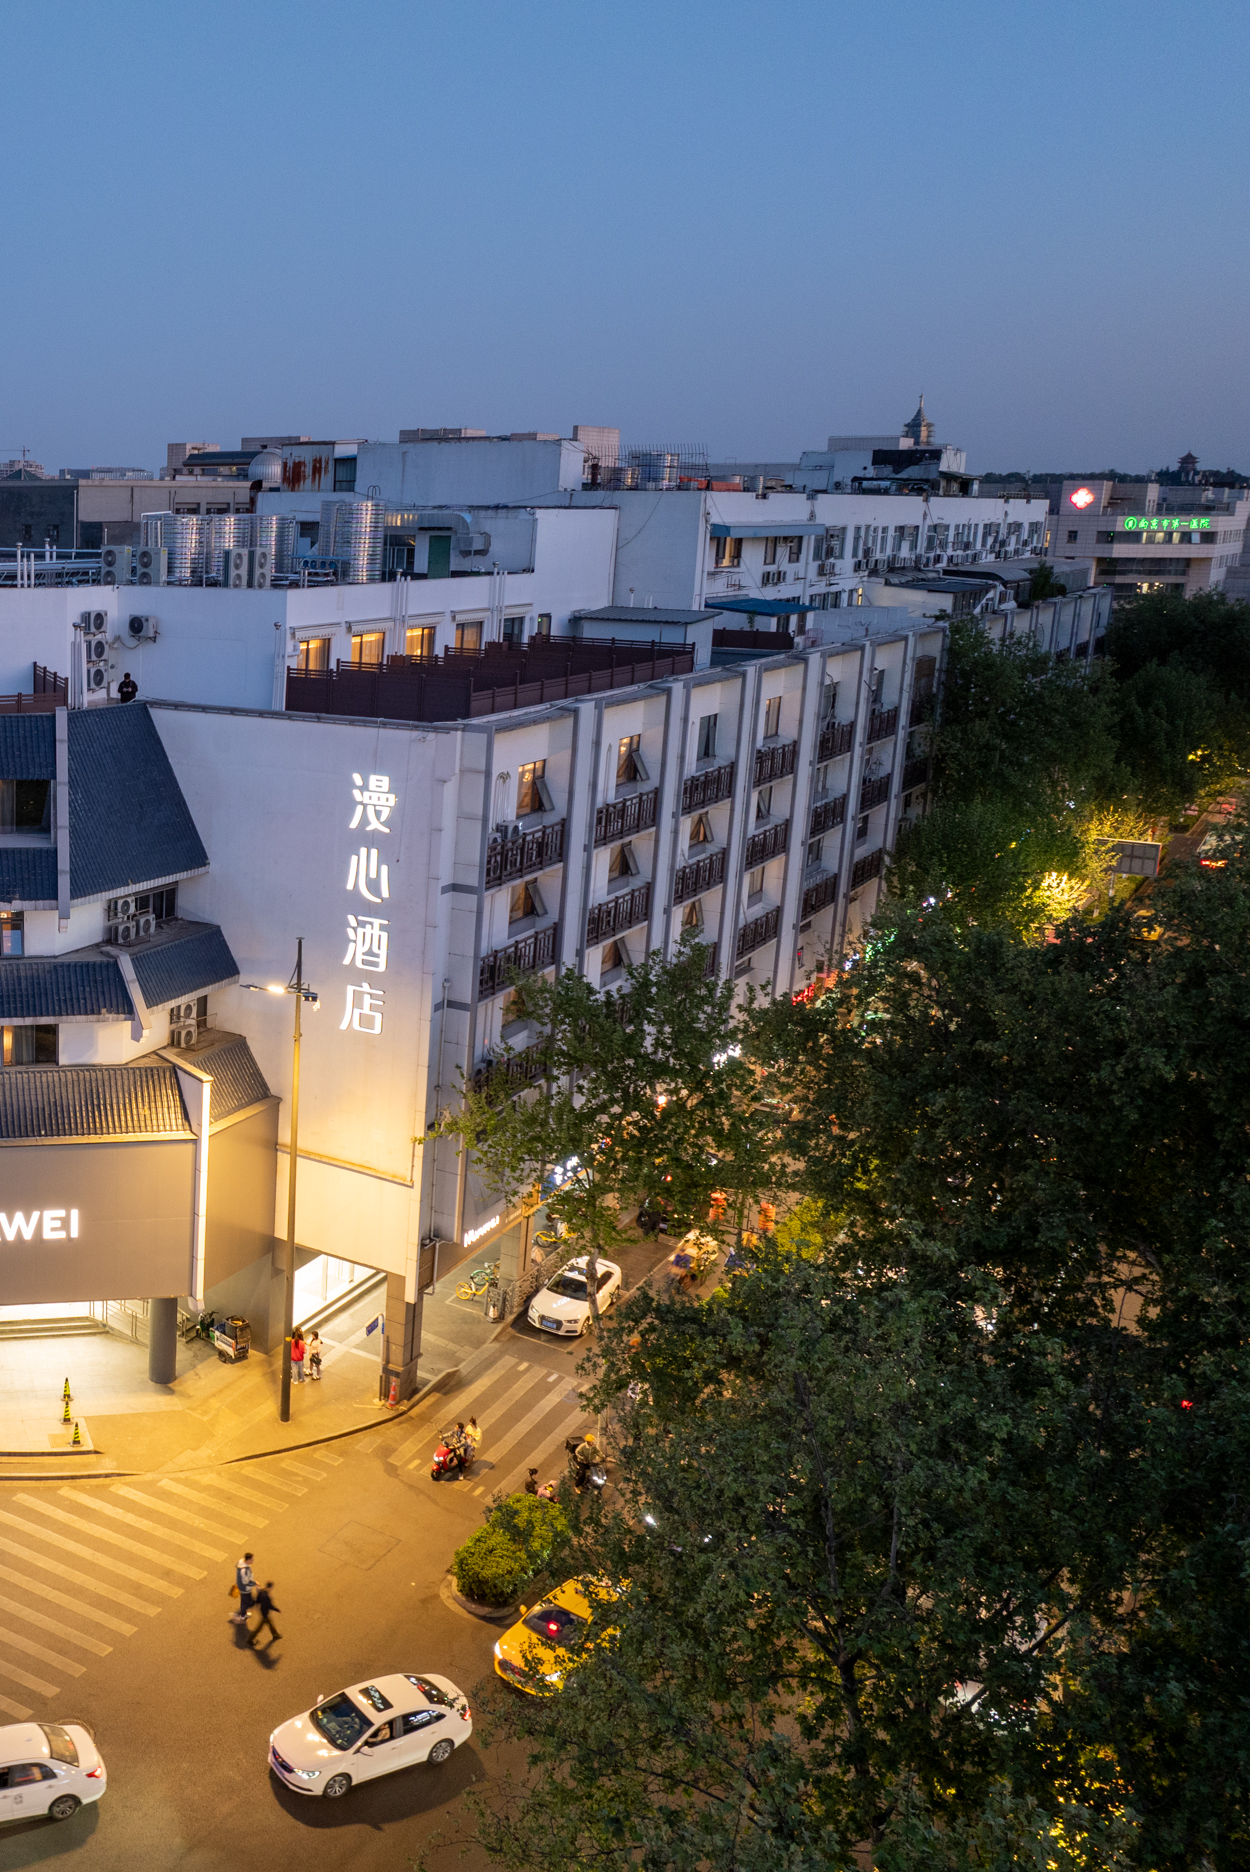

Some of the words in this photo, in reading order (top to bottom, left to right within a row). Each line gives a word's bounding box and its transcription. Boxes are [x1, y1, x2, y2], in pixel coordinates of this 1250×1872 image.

[1138, 517, 1211, 531] 南京市第一医院
[339, 772, 397, 1035] 漫心酒店
